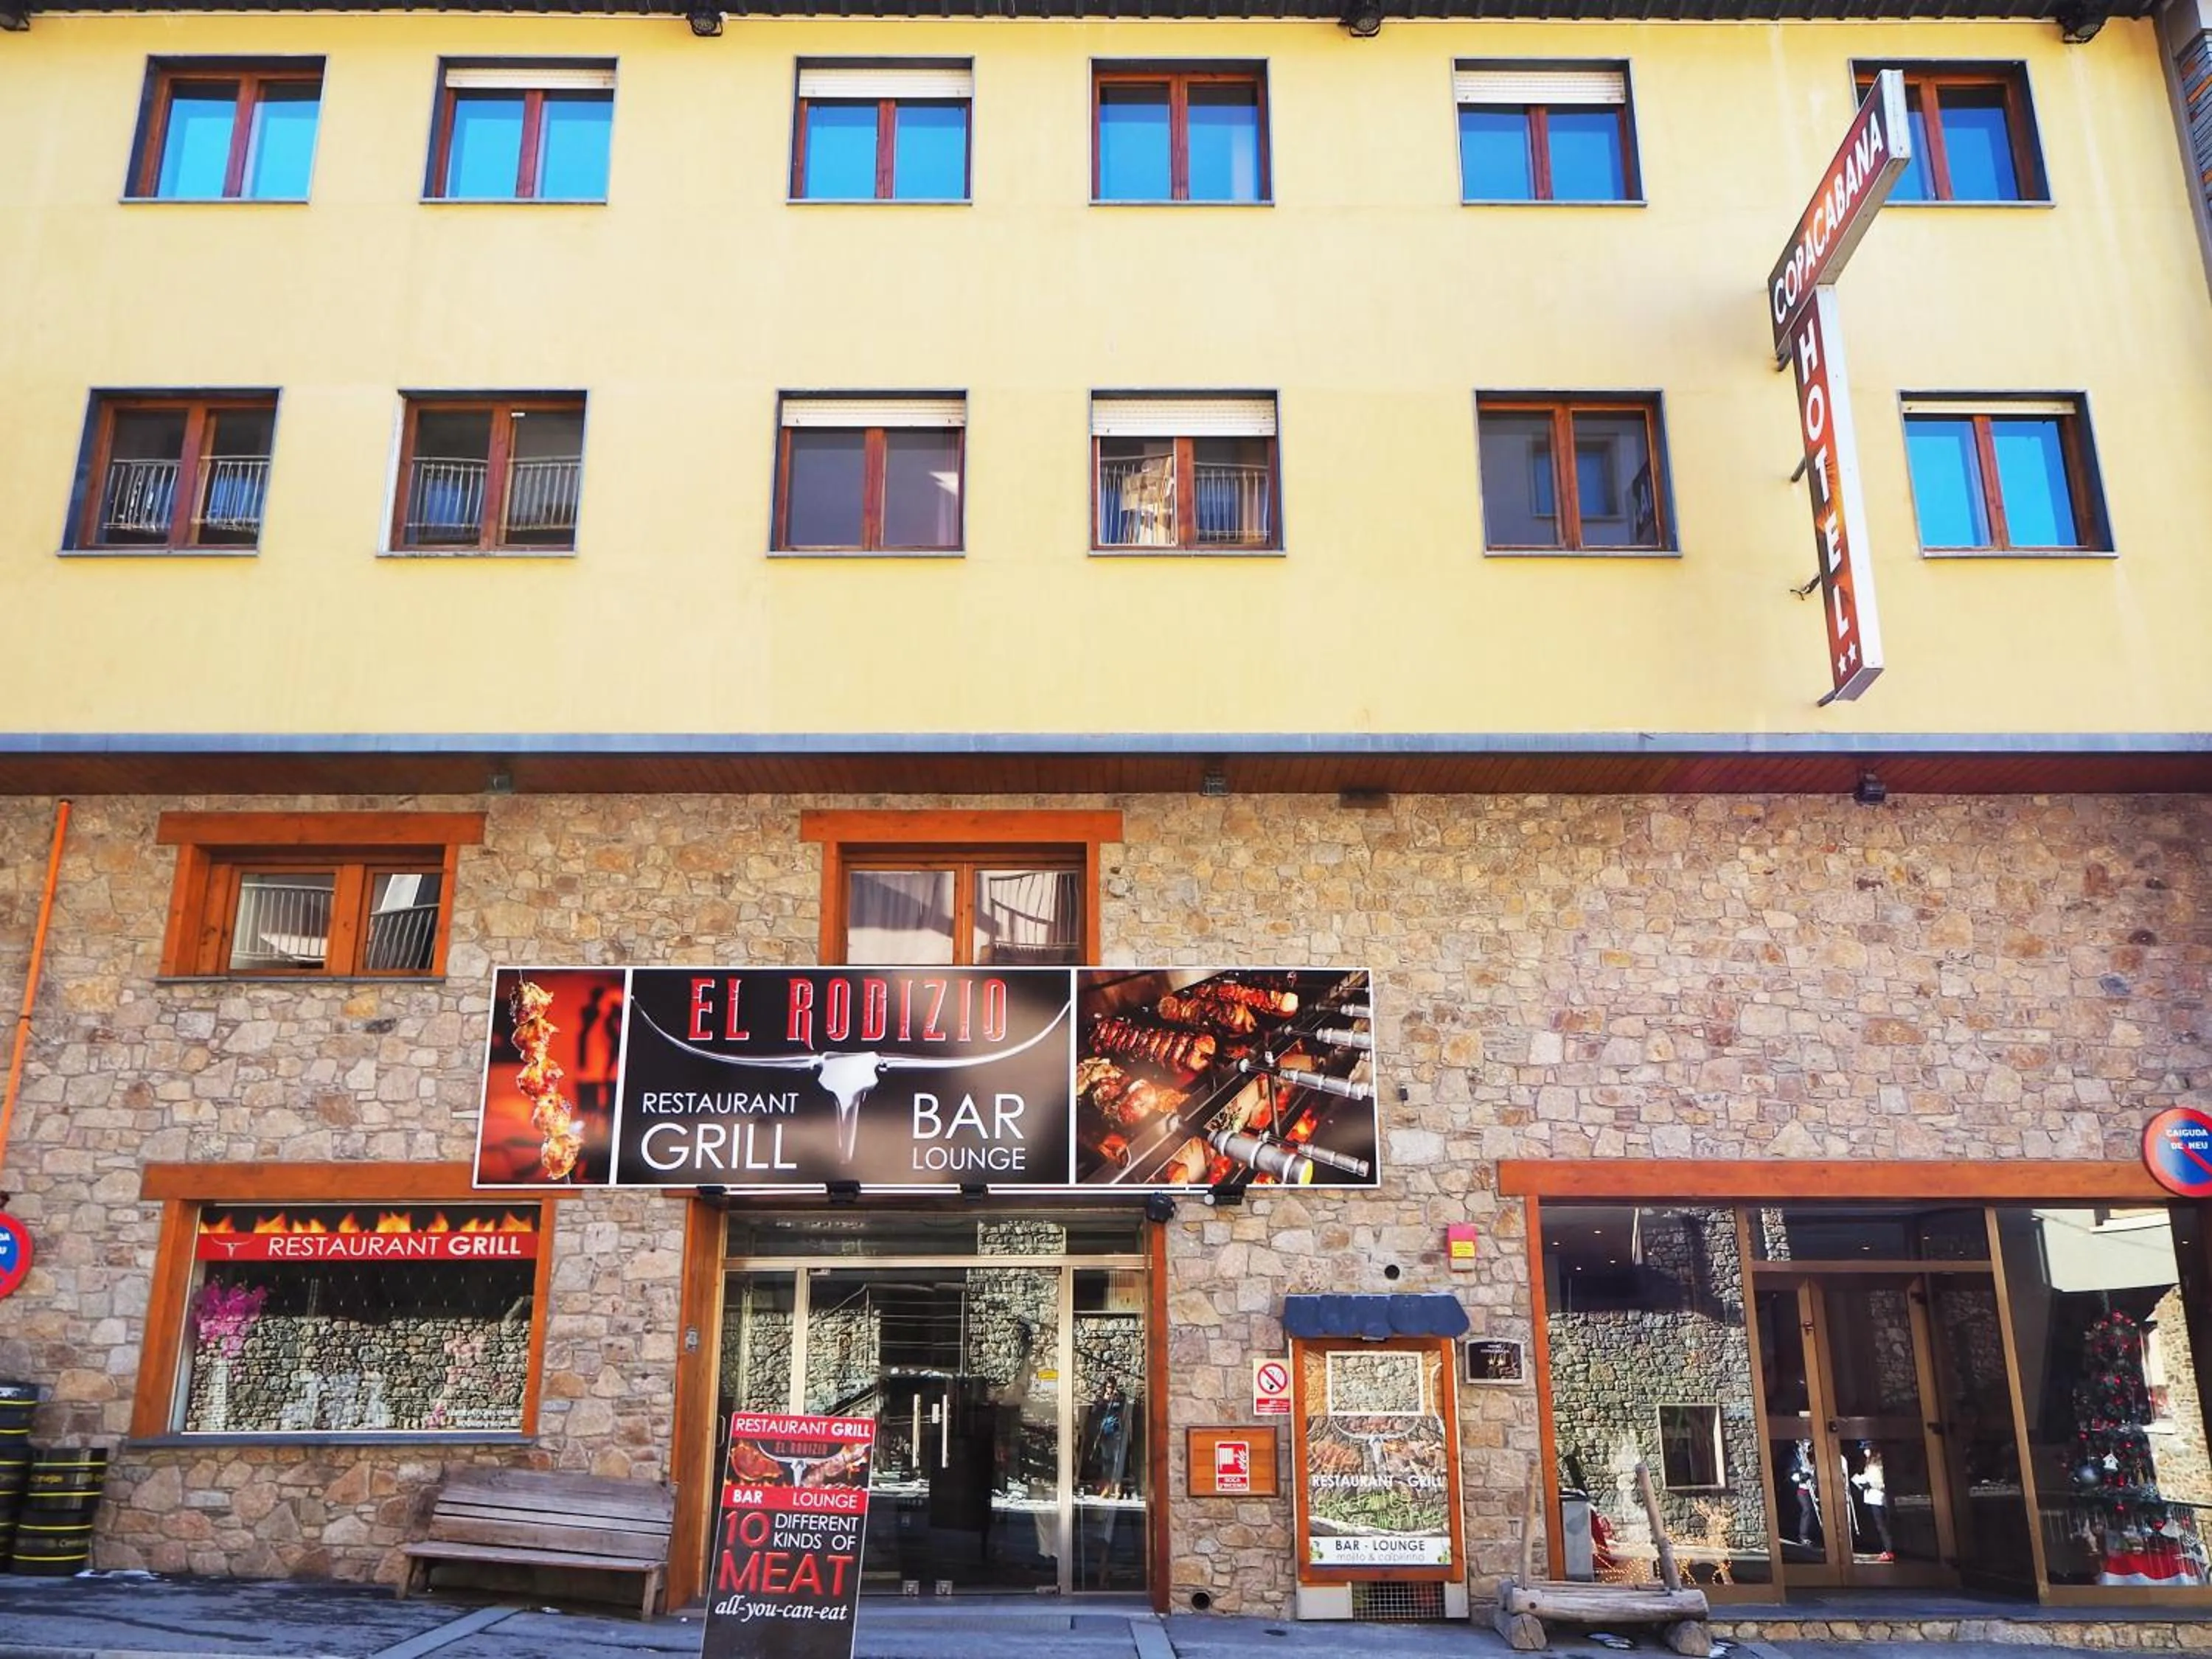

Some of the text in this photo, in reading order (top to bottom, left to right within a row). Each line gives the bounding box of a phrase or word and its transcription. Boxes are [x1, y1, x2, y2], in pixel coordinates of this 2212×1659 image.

[1774, 111, 1883, 324] COPACABANA
[1799, 319, 1849, 638] HOTEL
[688, 978, 1007, 1050] EL RODIZIO
[641, 1093, 799, 1114] RESTAURANT
[913, 1093, 1026, 1140] BAR
[641, 1123, 798, 1170] GRILL
[913, 1147, 1026, 1171] LOUNGE
[268, 1236, 521, 1256] RESTAURANT GRILL
[736, 1417, 871, 1437] RESTAURANT GRILL
[1312, 1475, 1394, 1488] RESTAURANT
[1408, 1475, 1443, 1488] GRILL
[732, 1489, 858, 1509] BAR LOUNGE
[725, 1511, 771, 1548] 10
[775, 1514, 860, 1532] DIFFERENT
[773, 1532, 857, 1551] KINDS OF
[1335, 1540, 1360, 1551] BAR
[1372, 1540, 1426, 1551] LOUNGE
[717, 1549, 855, 1597] MEAT
[714, 1594, 849, 1622] all-you-can-eat
